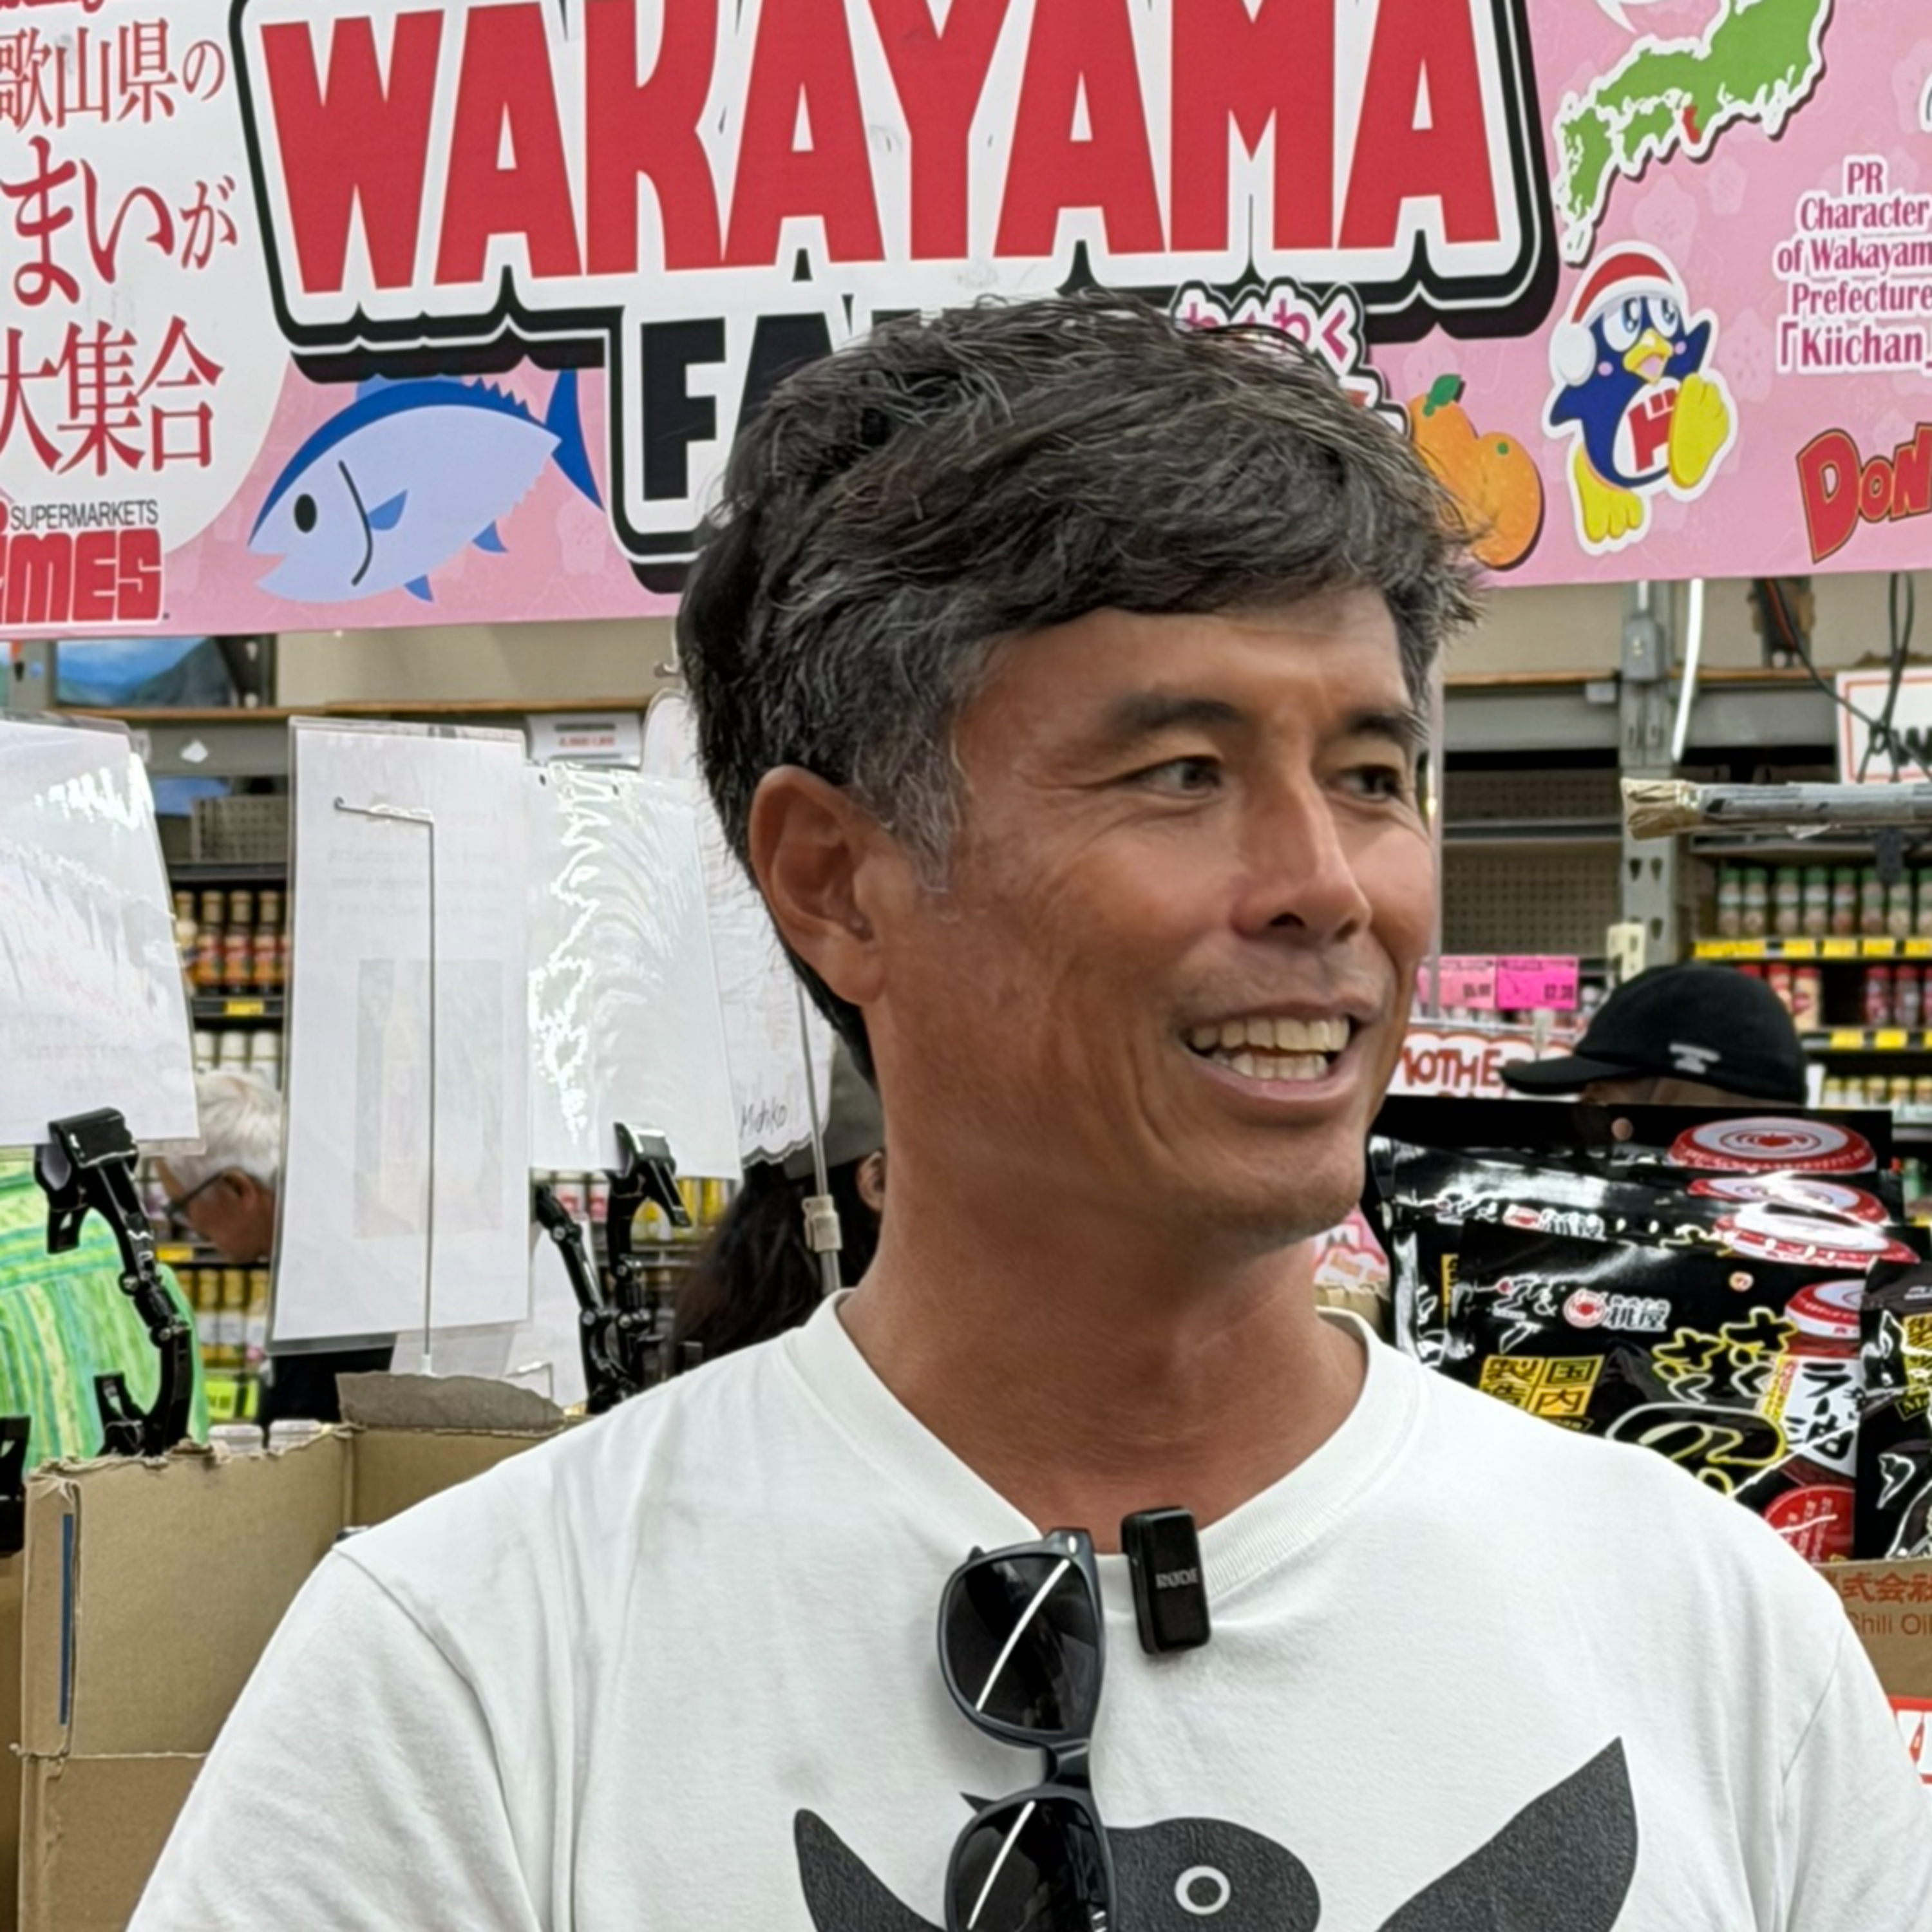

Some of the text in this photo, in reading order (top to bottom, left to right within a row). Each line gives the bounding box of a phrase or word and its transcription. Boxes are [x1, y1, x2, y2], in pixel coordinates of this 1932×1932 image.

[260, 0, 1501, 294] WAKAYAMA
[1847, 162, 1884, 194] PR
[0, 135, 238, 307] まいが
[1800, 196, 1930, 232] Character
[1777, 239, 1804, 273] of
[1792, 281, 1932, 316] Prefecture
[0, 316, 223, 477] 大集合
[10, 498, 159, 531] SUPERMARKETS
[0, 528, 161, 625] MES
[1825, 1570, 1932, 1604] 式会社
